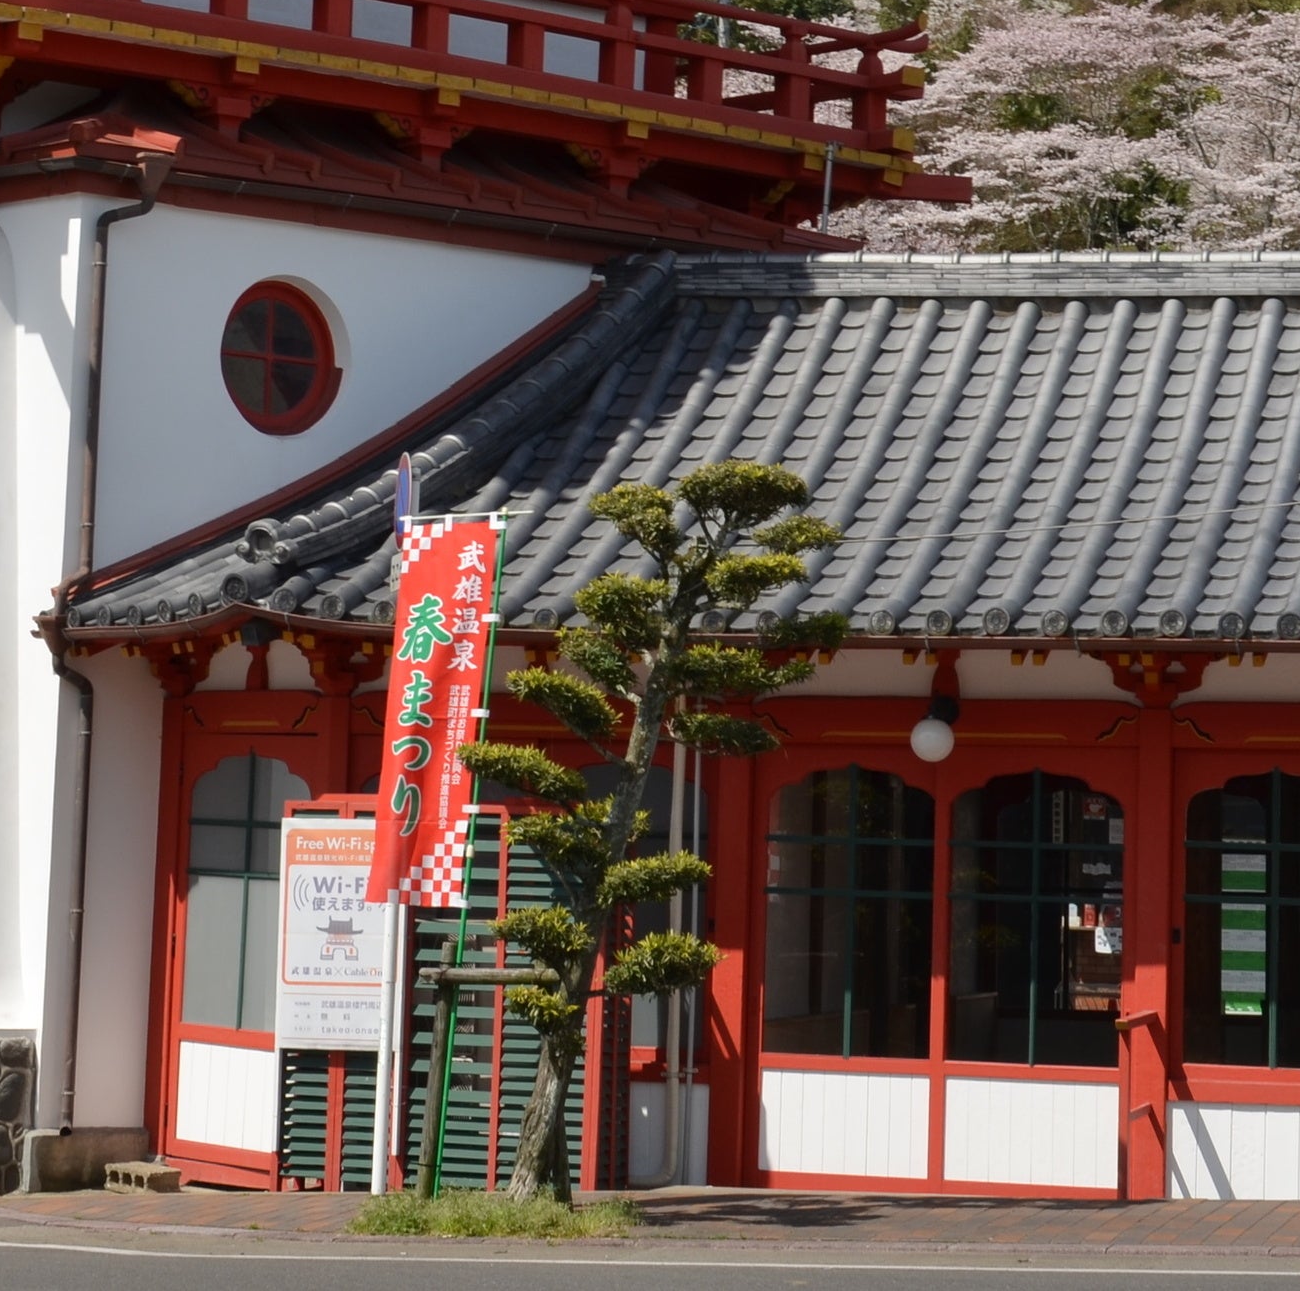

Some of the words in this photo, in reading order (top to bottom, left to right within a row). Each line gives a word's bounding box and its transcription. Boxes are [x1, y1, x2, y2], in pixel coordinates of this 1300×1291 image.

[447, 540, 486, 672] 武雄温泉
[391, 593, 453, 837] 春まつり
[296, 836, 324, 850] Free
[327, 837, 361, 850] Wi-Fi
[313, 876, 369, 894] Wi-F
